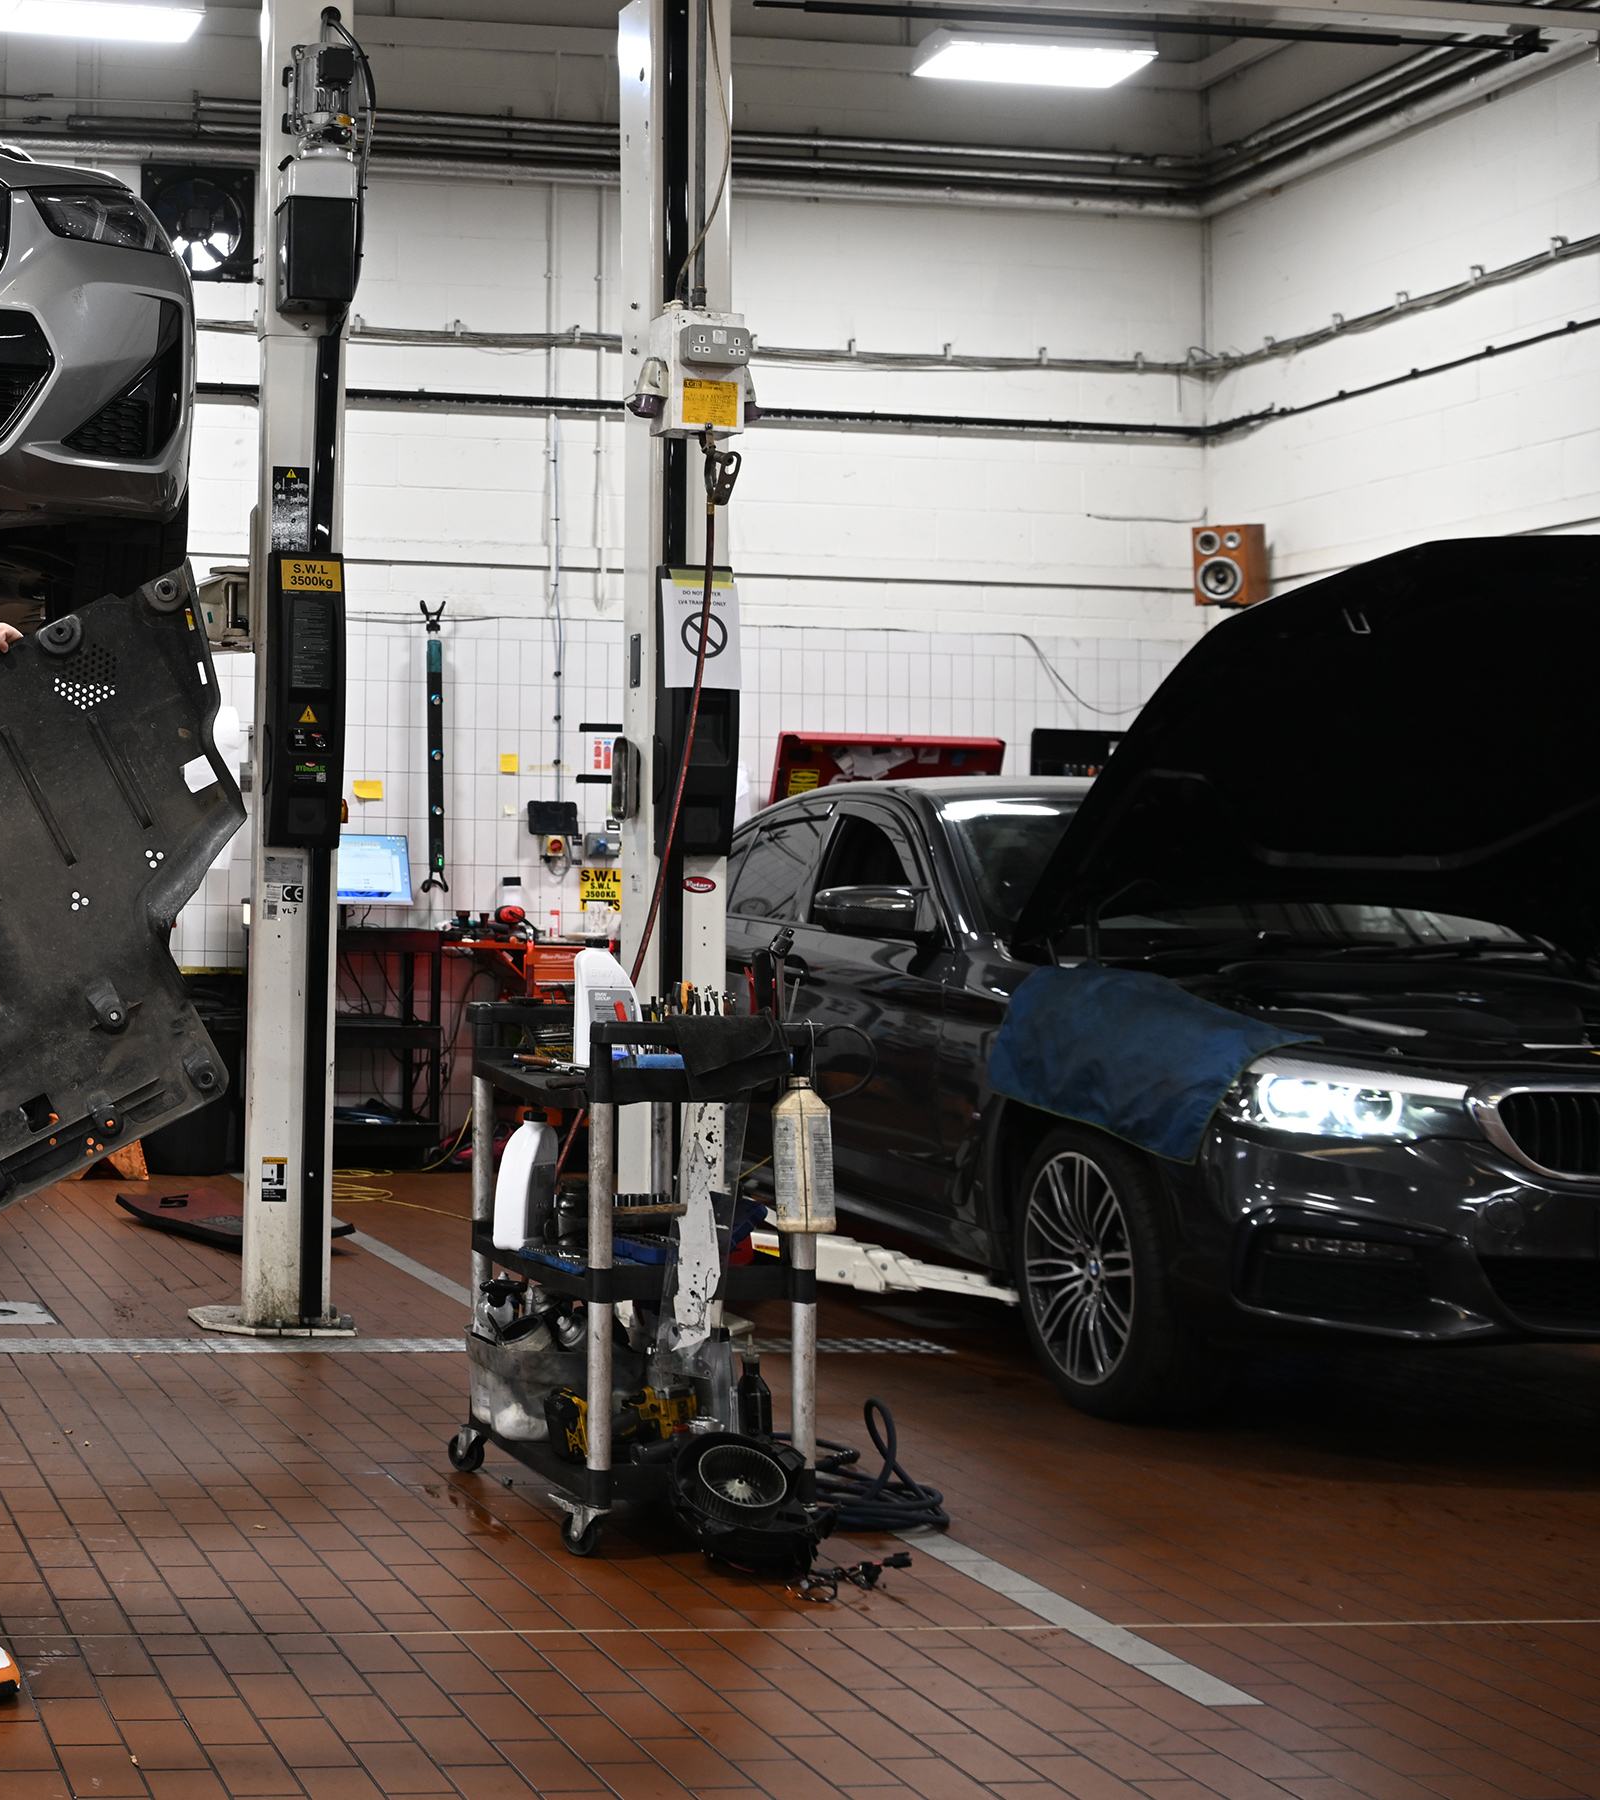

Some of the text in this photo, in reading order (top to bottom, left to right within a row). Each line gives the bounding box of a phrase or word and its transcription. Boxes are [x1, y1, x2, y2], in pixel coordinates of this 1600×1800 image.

[293, 563, 328, 574] S.W.L
[290, 575, 333, 589] 3500kg
[580, 870, 621, 882] S.W.L
[590, 882, 611, 890] S.W.L
[685, 879, 713, 889] Rotary
